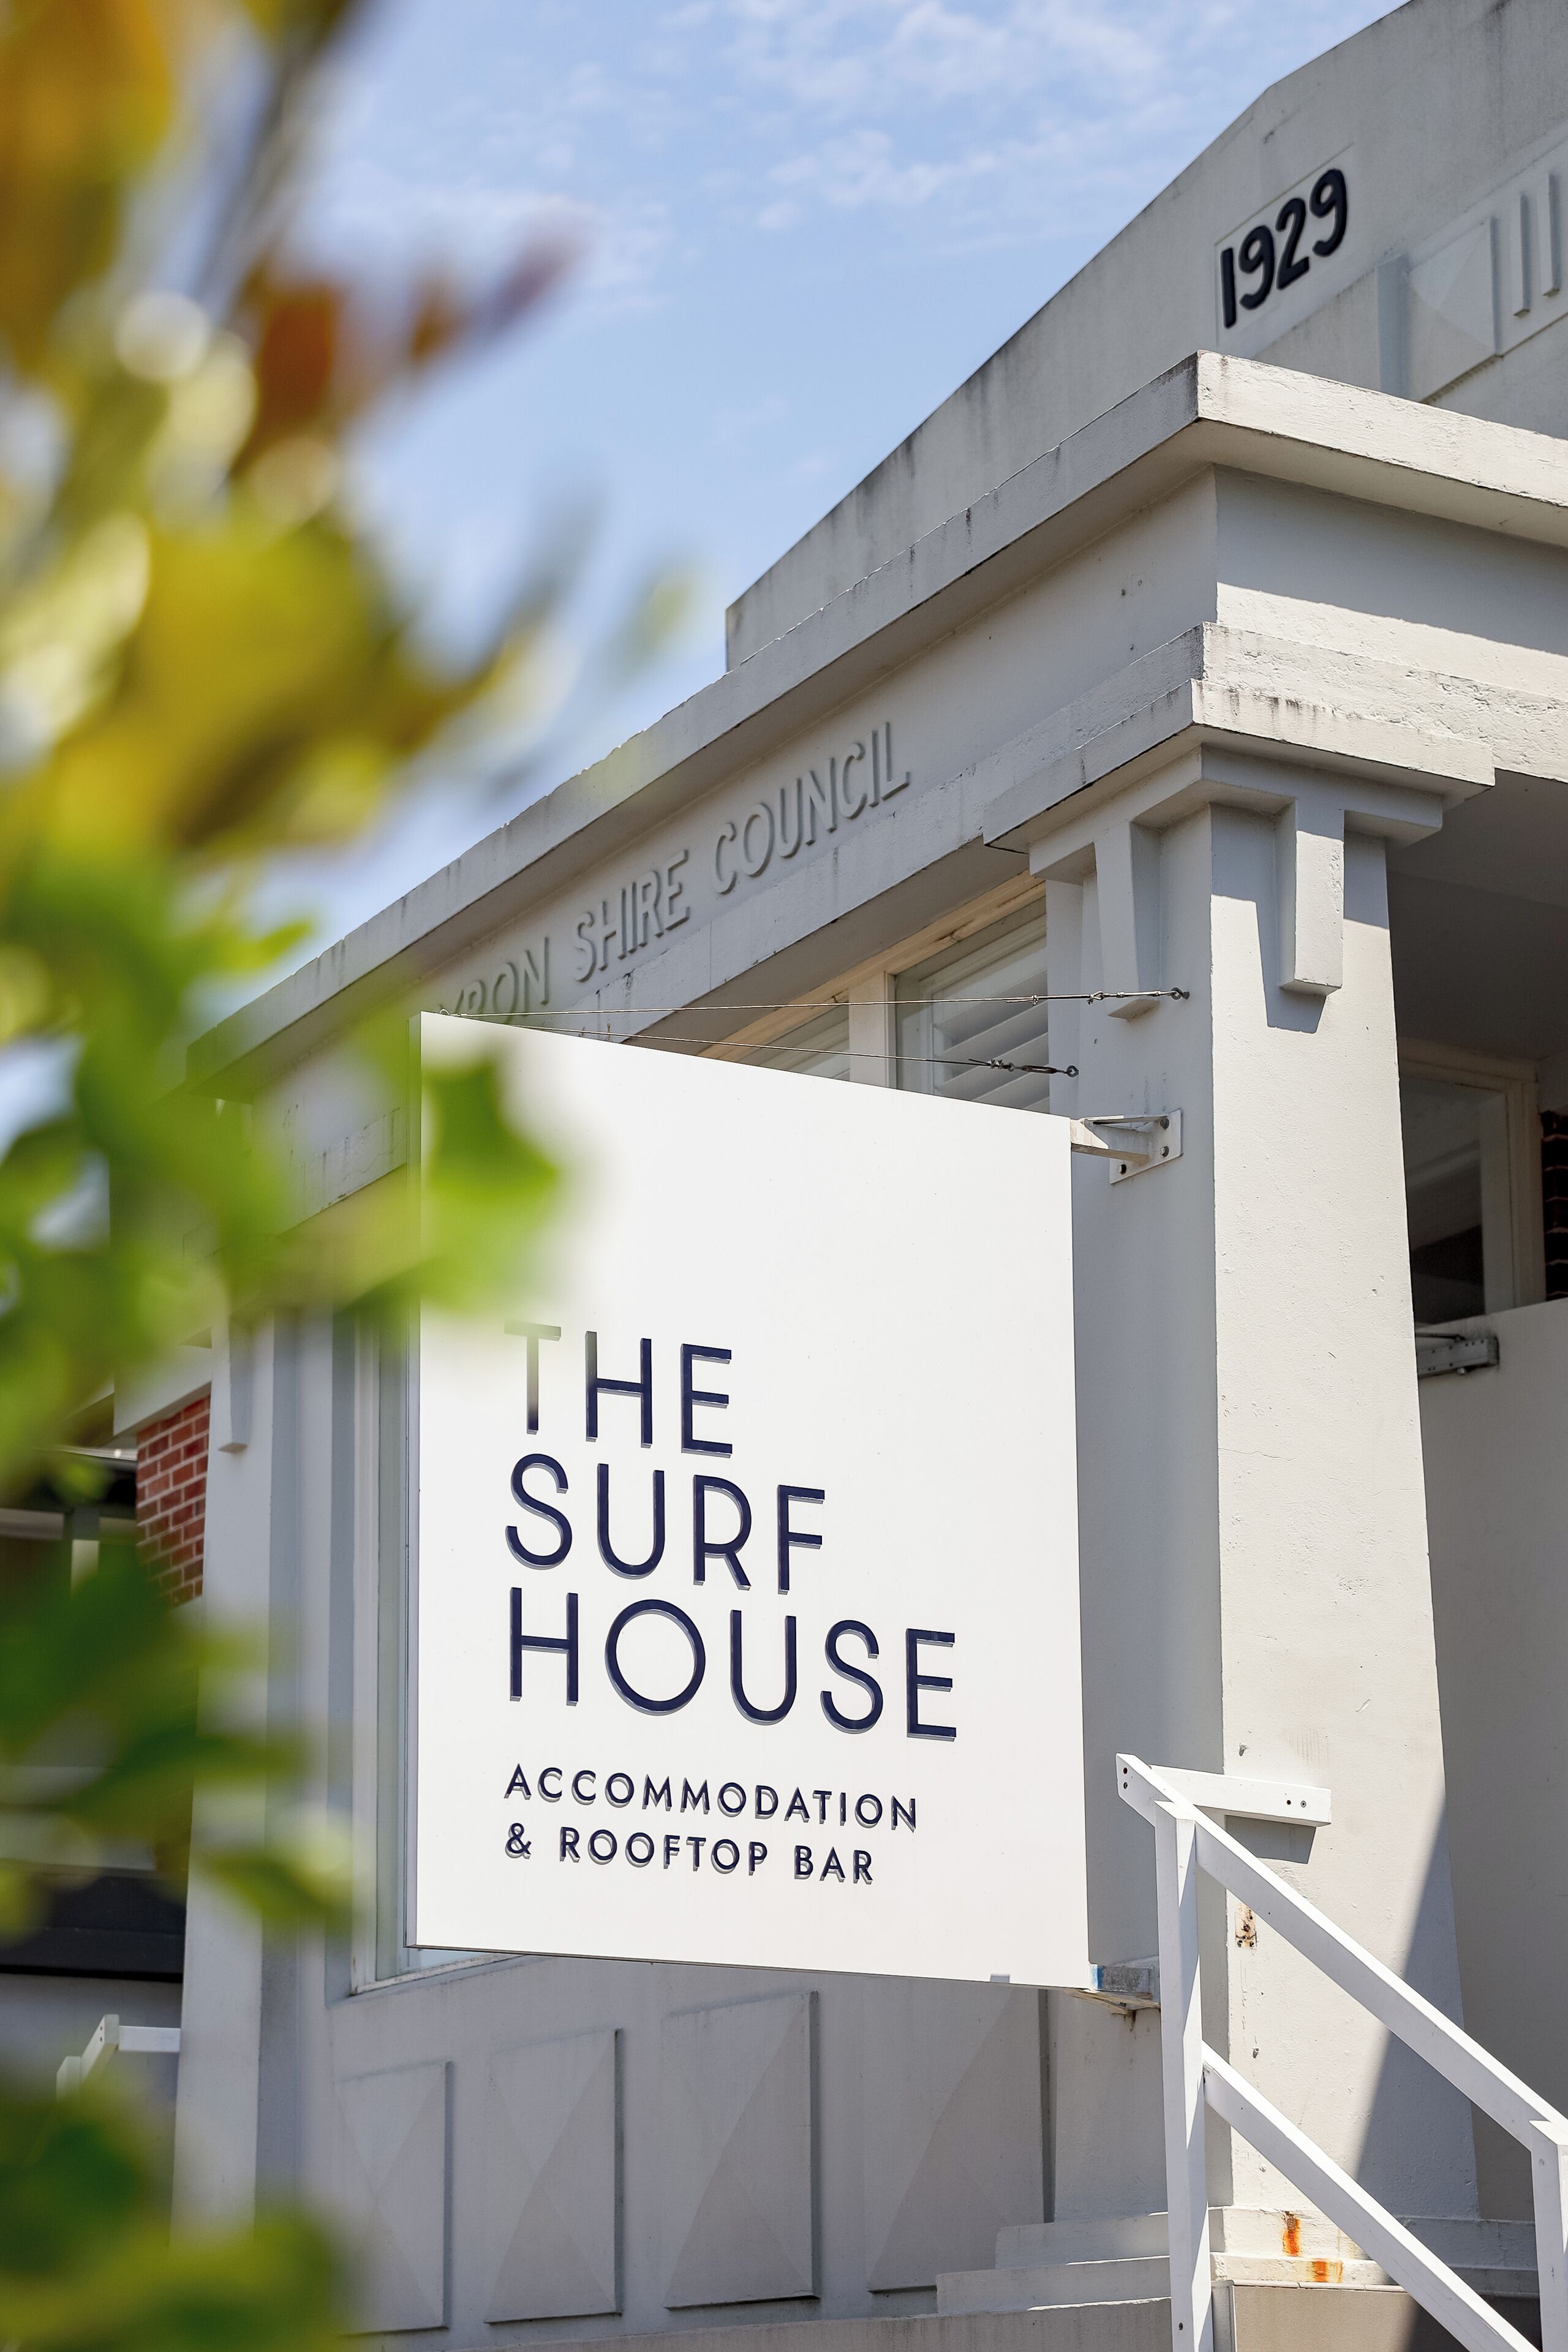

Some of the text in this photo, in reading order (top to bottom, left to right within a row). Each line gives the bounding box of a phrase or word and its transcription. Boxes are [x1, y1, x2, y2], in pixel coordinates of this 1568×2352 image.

[1220, 168, 1347, 329] 1929
[576, 849, 690, 982] SHIRE
[714, 722, 911, 895] COUNCIL
[504, 1319, 733, 1458] THE
[505, 1453, 825, 1594] SURF
[510, 1588, 957, 1742] HOUSE
[504, 1763, 916, 1833] ACCOMMODATION
[505, 1823, 873, 1885] & ROOFTOP BAR
